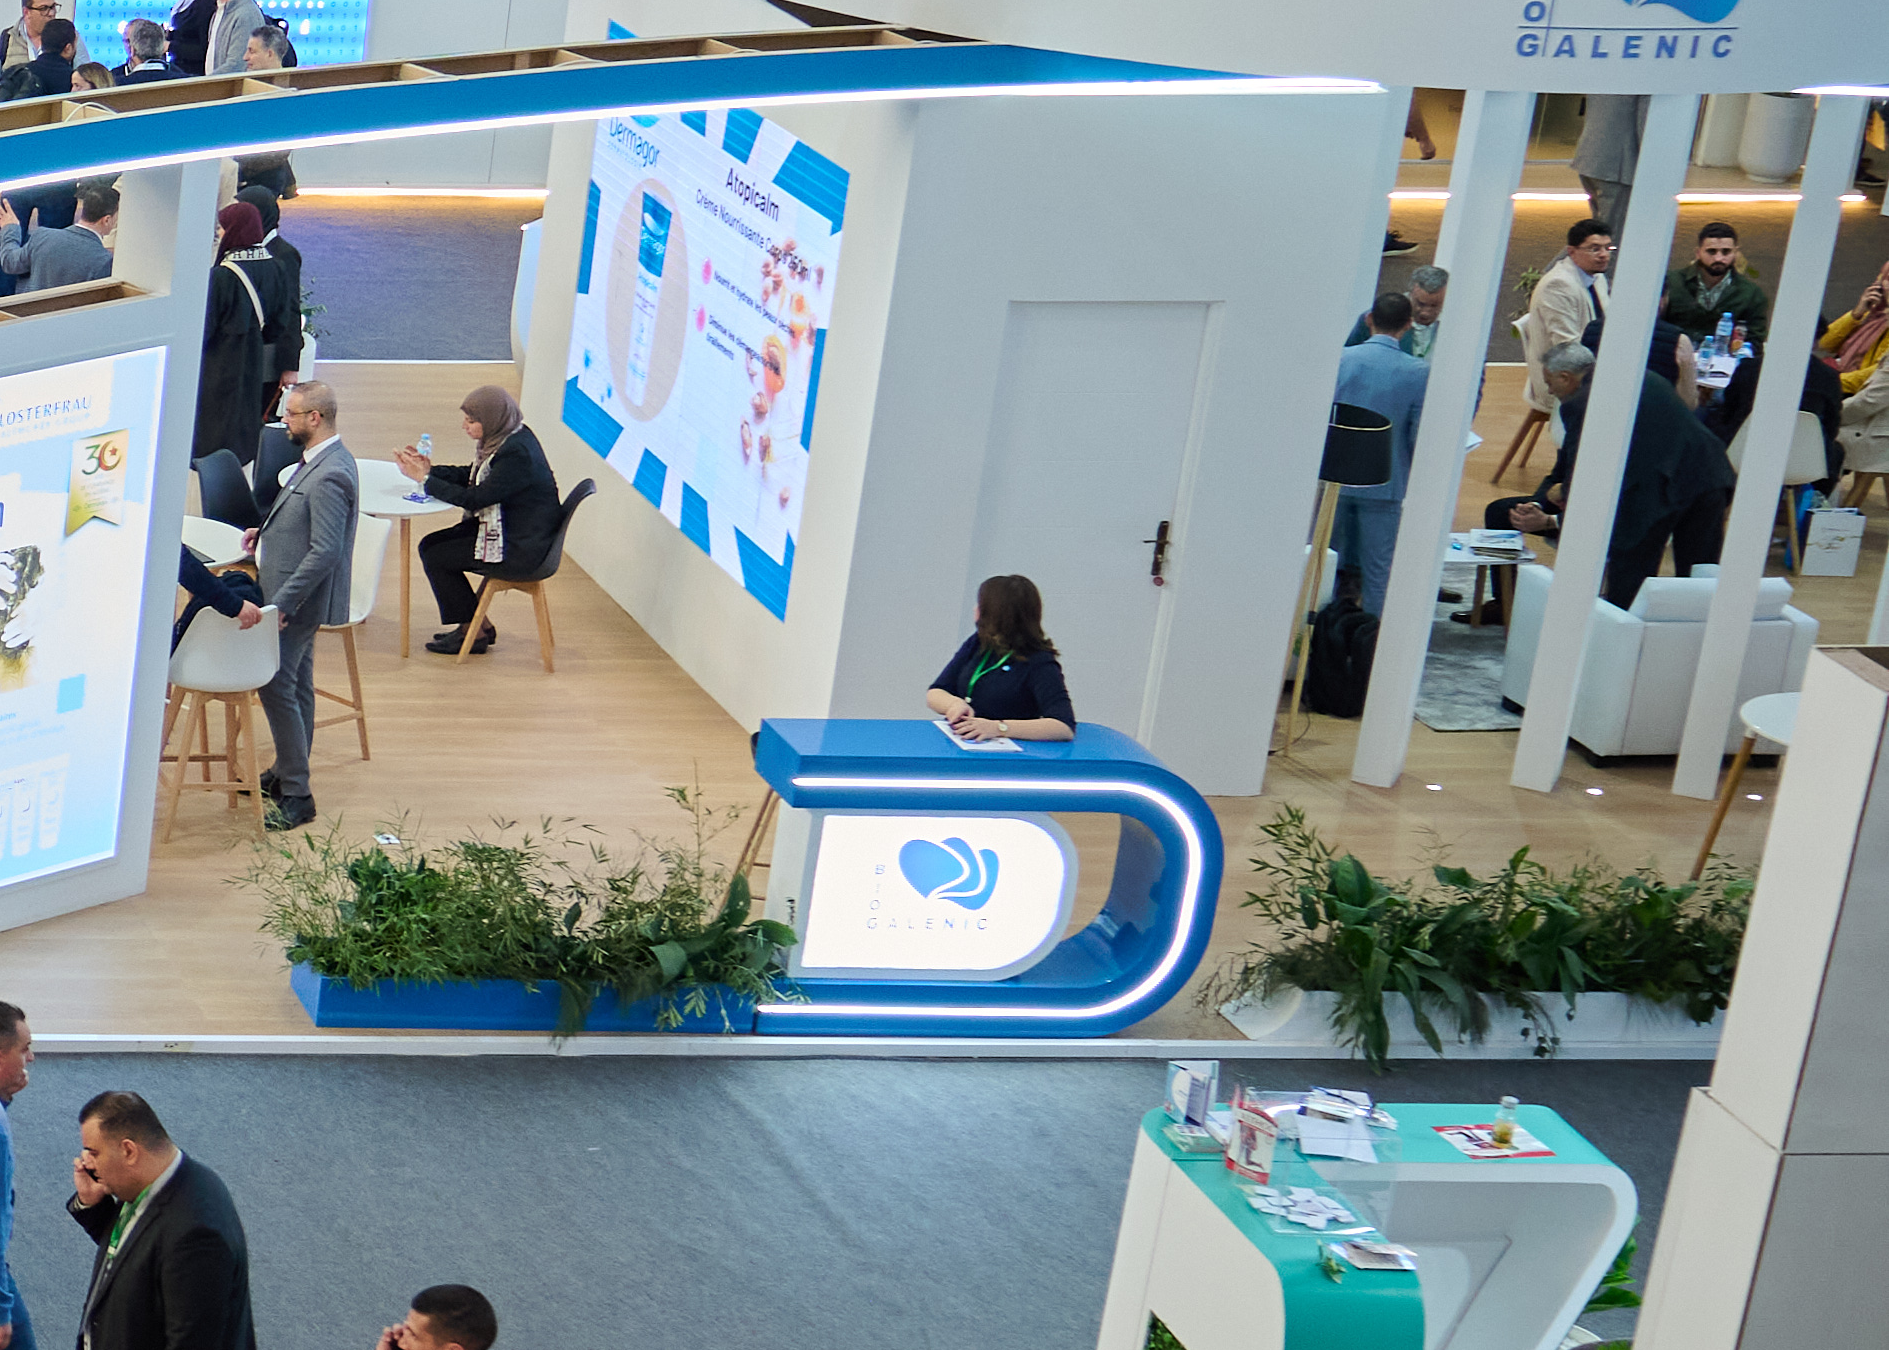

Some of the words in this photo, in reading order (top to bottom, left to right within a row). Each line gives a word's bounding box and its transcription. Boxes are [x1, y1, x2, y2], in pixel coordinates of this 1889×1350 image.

[1515, 33, 1734, 60] GALENIC
[609, 116, 660, 168] Dermagor
[725, 167, 780, 222] Atopicalm
